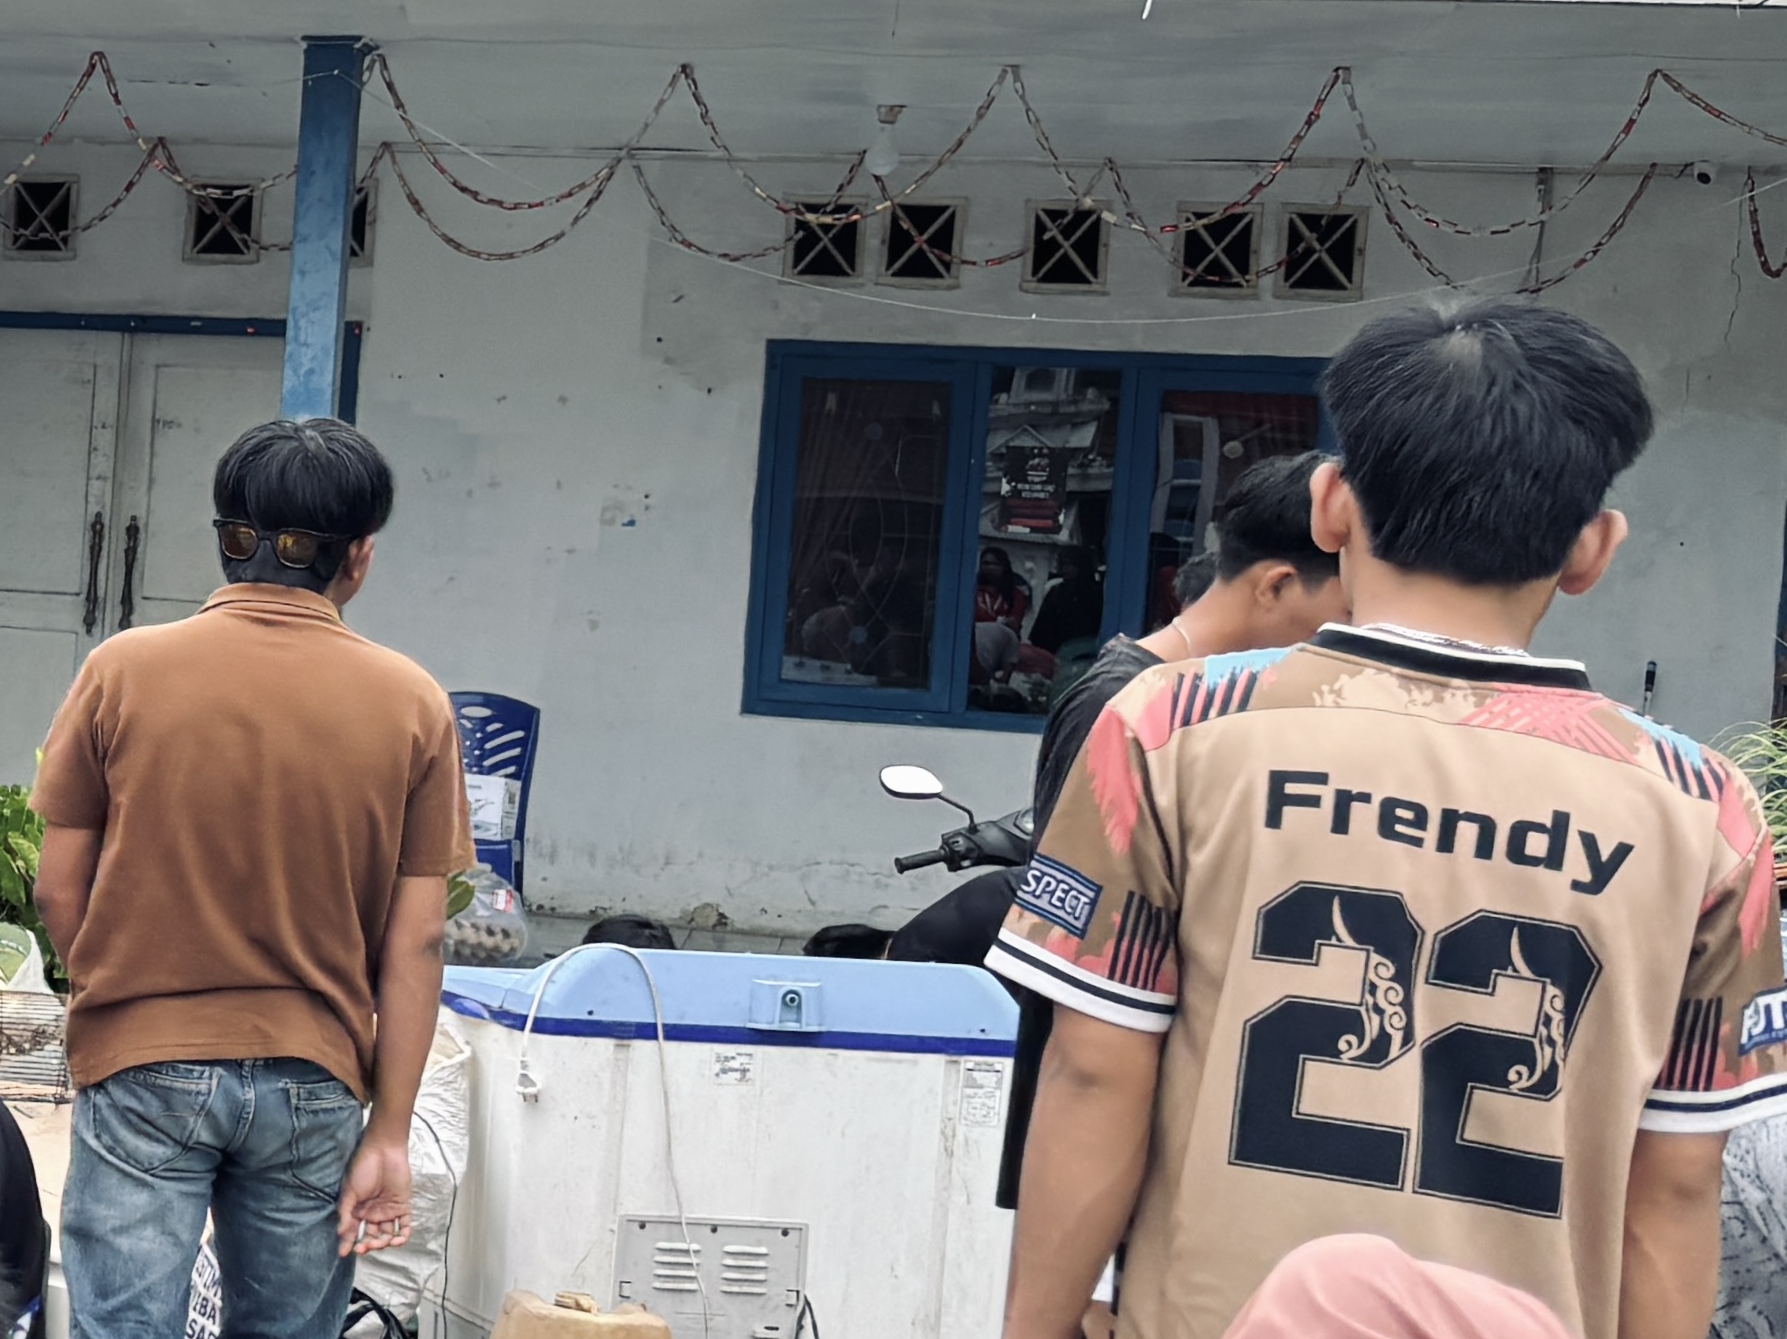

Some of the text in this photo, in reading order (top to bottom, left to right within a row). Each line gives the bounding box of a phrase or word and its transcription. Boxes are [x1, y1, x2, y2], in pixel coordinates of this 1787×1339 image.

[1020, 868, 1090, 918] SPECT
[1264, 768, 1635, 896] Frendy
[1228, 880, 1604, 1220] 22
